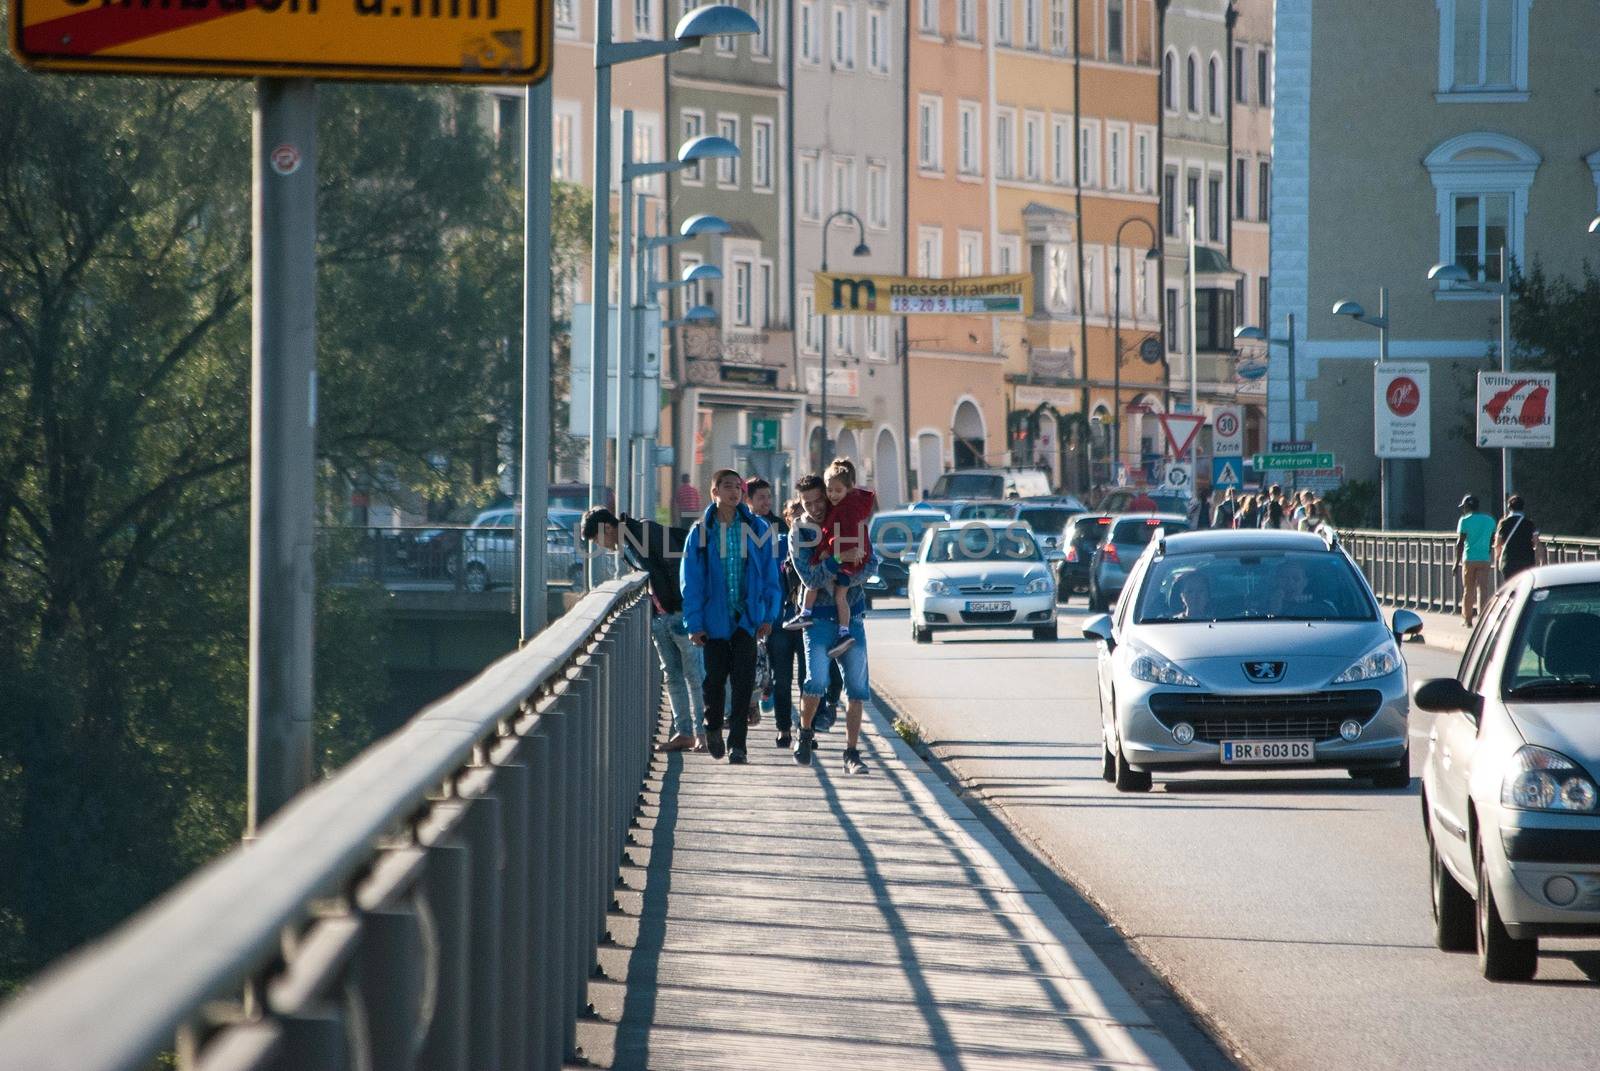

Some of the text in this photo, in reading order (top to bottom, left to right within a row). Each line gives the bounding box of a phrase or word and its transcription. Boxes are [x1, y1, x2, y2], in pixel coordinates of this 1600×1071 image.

[1220, 418, 1234, 432] 30
[1216, 441, 1240, 452] Zone
[1269, 457, 1313, 467] Zentrum
[1235, 743, 1310, 758] BR 603 DS
